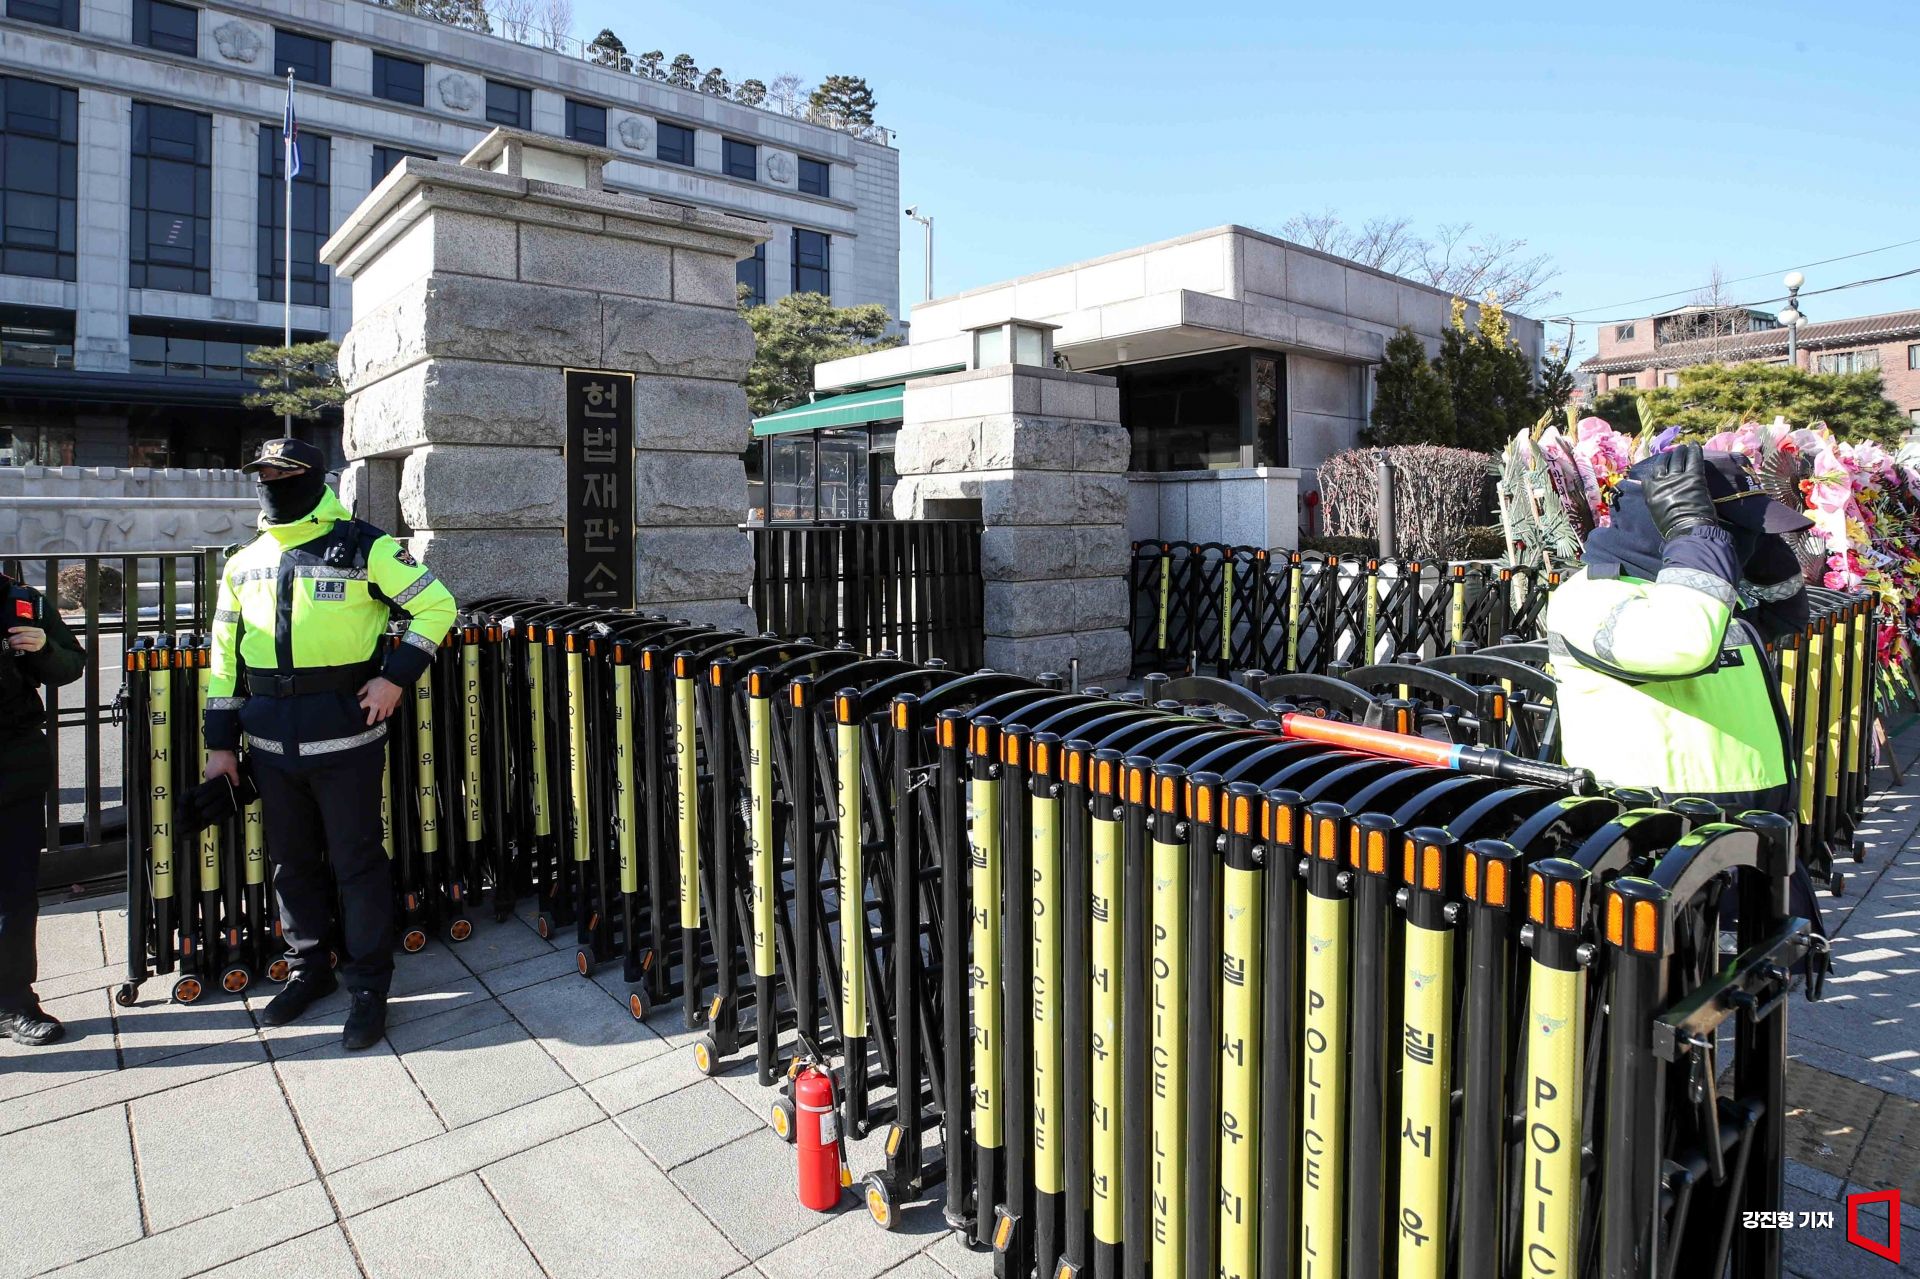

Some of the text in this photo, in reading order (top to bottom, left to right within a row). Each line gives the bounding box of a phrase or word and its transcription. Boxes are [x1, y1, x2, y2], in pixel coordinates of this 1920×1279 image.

[318, 581, 343, 592] 경찰
[582, 381, 620, 599] 헌법재판소
[152, 711, 170, 875] 질서유지선
[204, 828, 215, 868] INE
[418, 687, 436, 832] 질서유지선
[468, 680, 479, 821] POLICE LINE
[972, 845, 989, 1110] 질서유지선
[1033, 869, 1047, 1152] POLICE LINE
[1091, 892, 1109, 1199] 질서유지선
[1153, 924, 1170, 1245] POLICE LINE
[1305, 989, 1327, 1190] POLICE
[1528, 1076, 1561, 1279] POLIC
